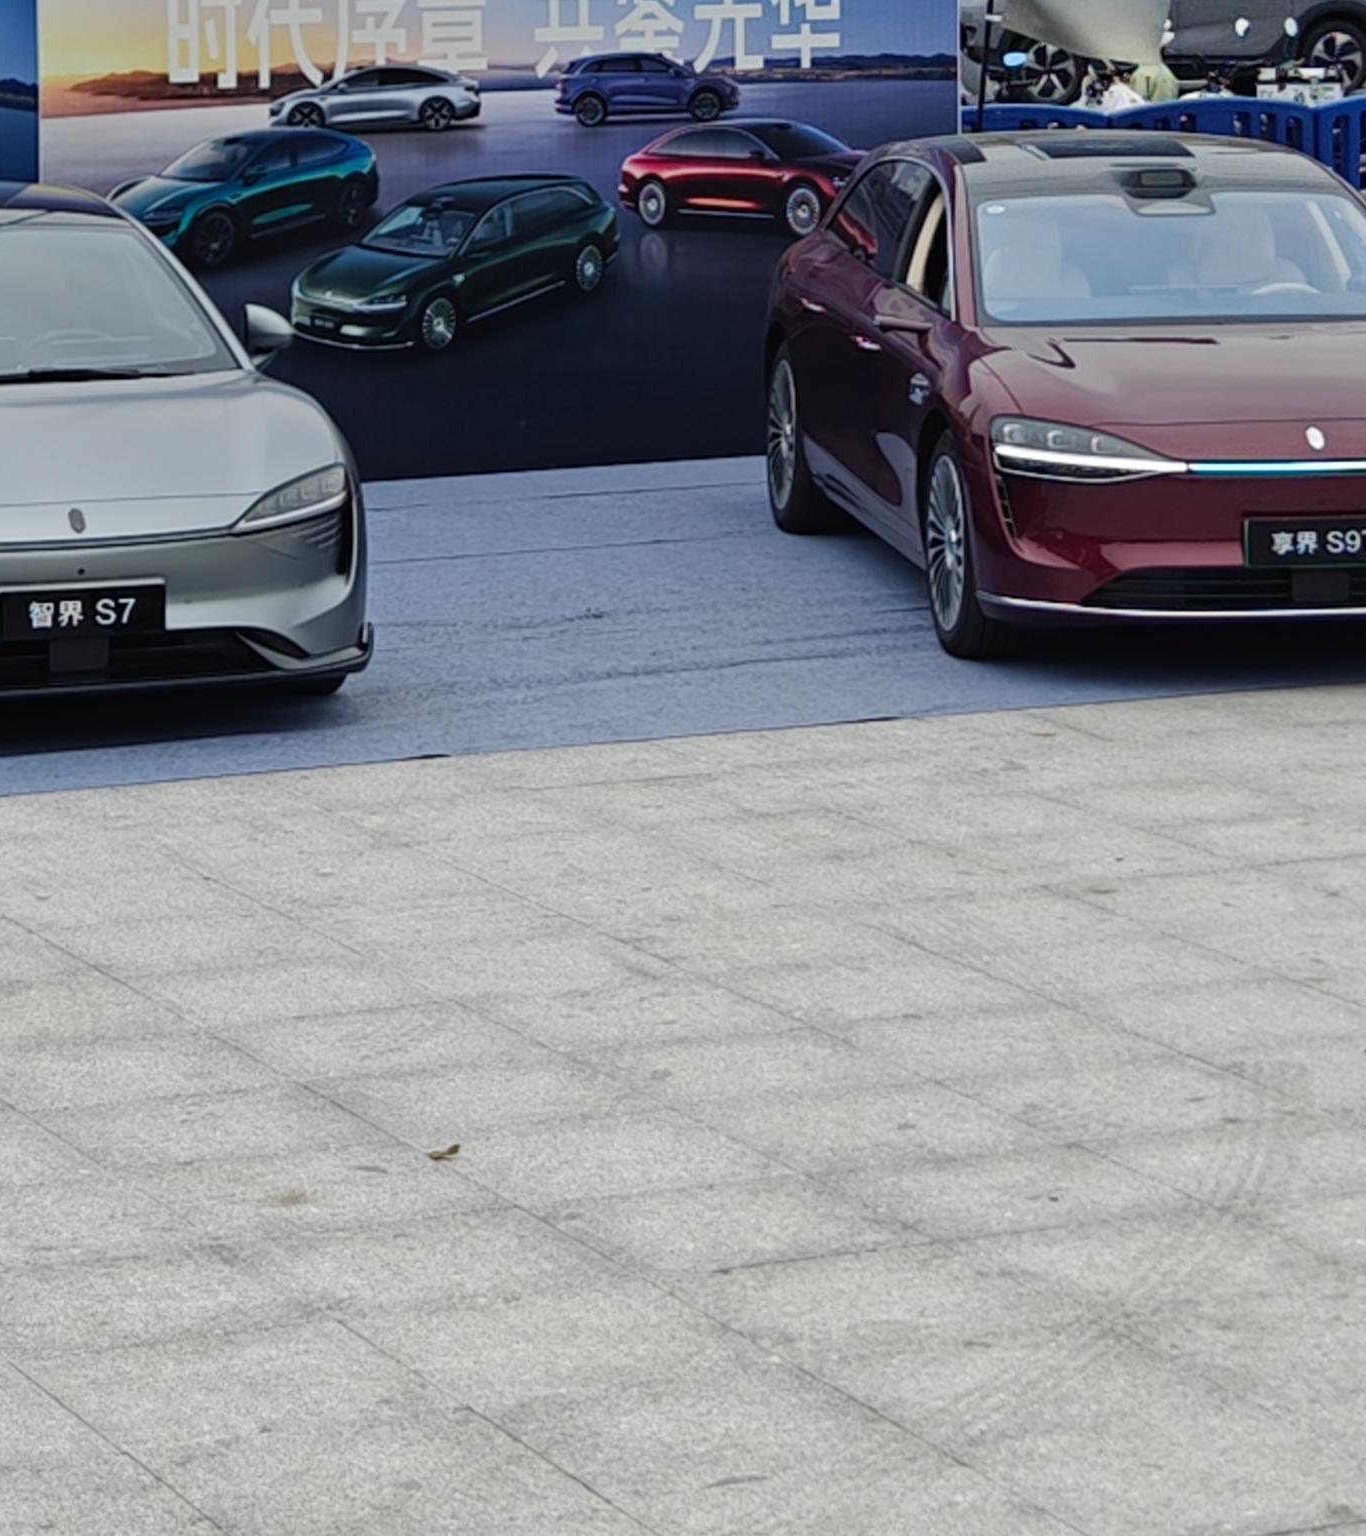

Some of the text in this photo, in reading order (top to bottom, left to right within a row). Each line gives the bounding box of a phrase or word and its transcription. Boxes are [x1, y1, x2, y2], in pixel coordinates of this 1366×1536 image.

[1271, 531, 1318, 555] 享界
[29, 598, 136, 629] 智界 S7
